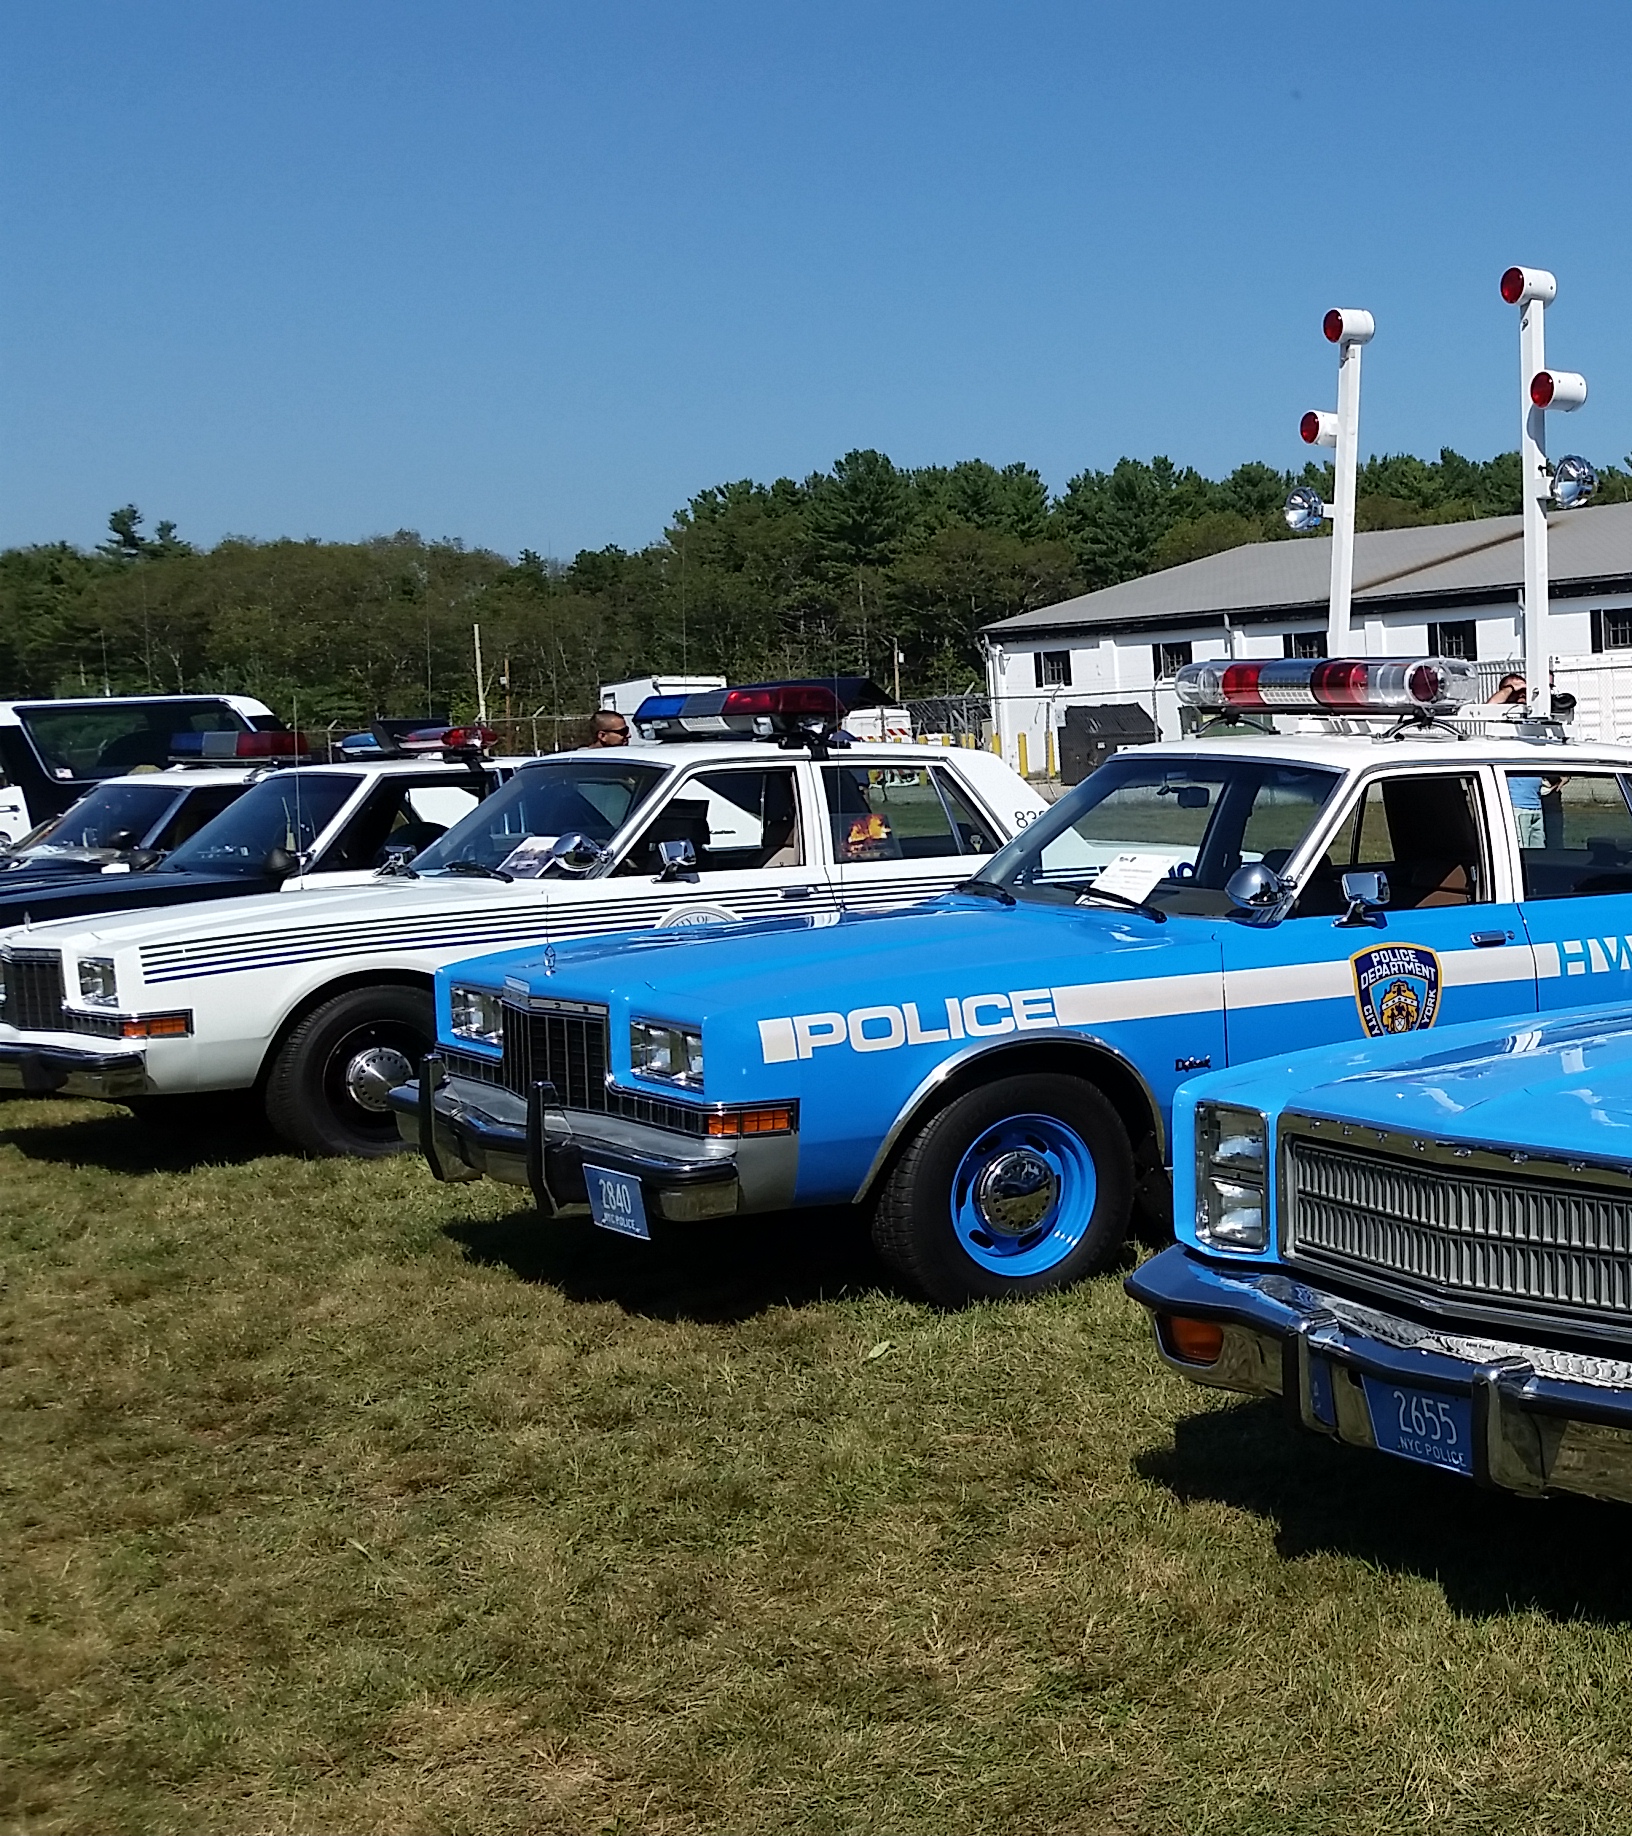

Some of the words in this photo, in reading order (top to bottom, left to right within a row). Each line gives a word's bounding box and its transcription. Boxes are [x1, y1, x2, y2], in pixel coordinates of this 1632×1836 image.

[1370, 948, 1419, 966] POLICE
[1360, 961, 1436, 990] DEPARTMENT
[1363, 1004, 1381, 1035] CITY
[1421, 988, 1437, 1024] YORK
[792, 988, 1059, 1060] POLICE
[599, 1179, 632, 1215] 2840
[616, 1217, 636, 1230] POLICE
[1393, 1390, 1458, 1445] 2655
[1399, 1436, 1423, 1454] NYC
[1424, 1443, 1467, 1467] POLICE
